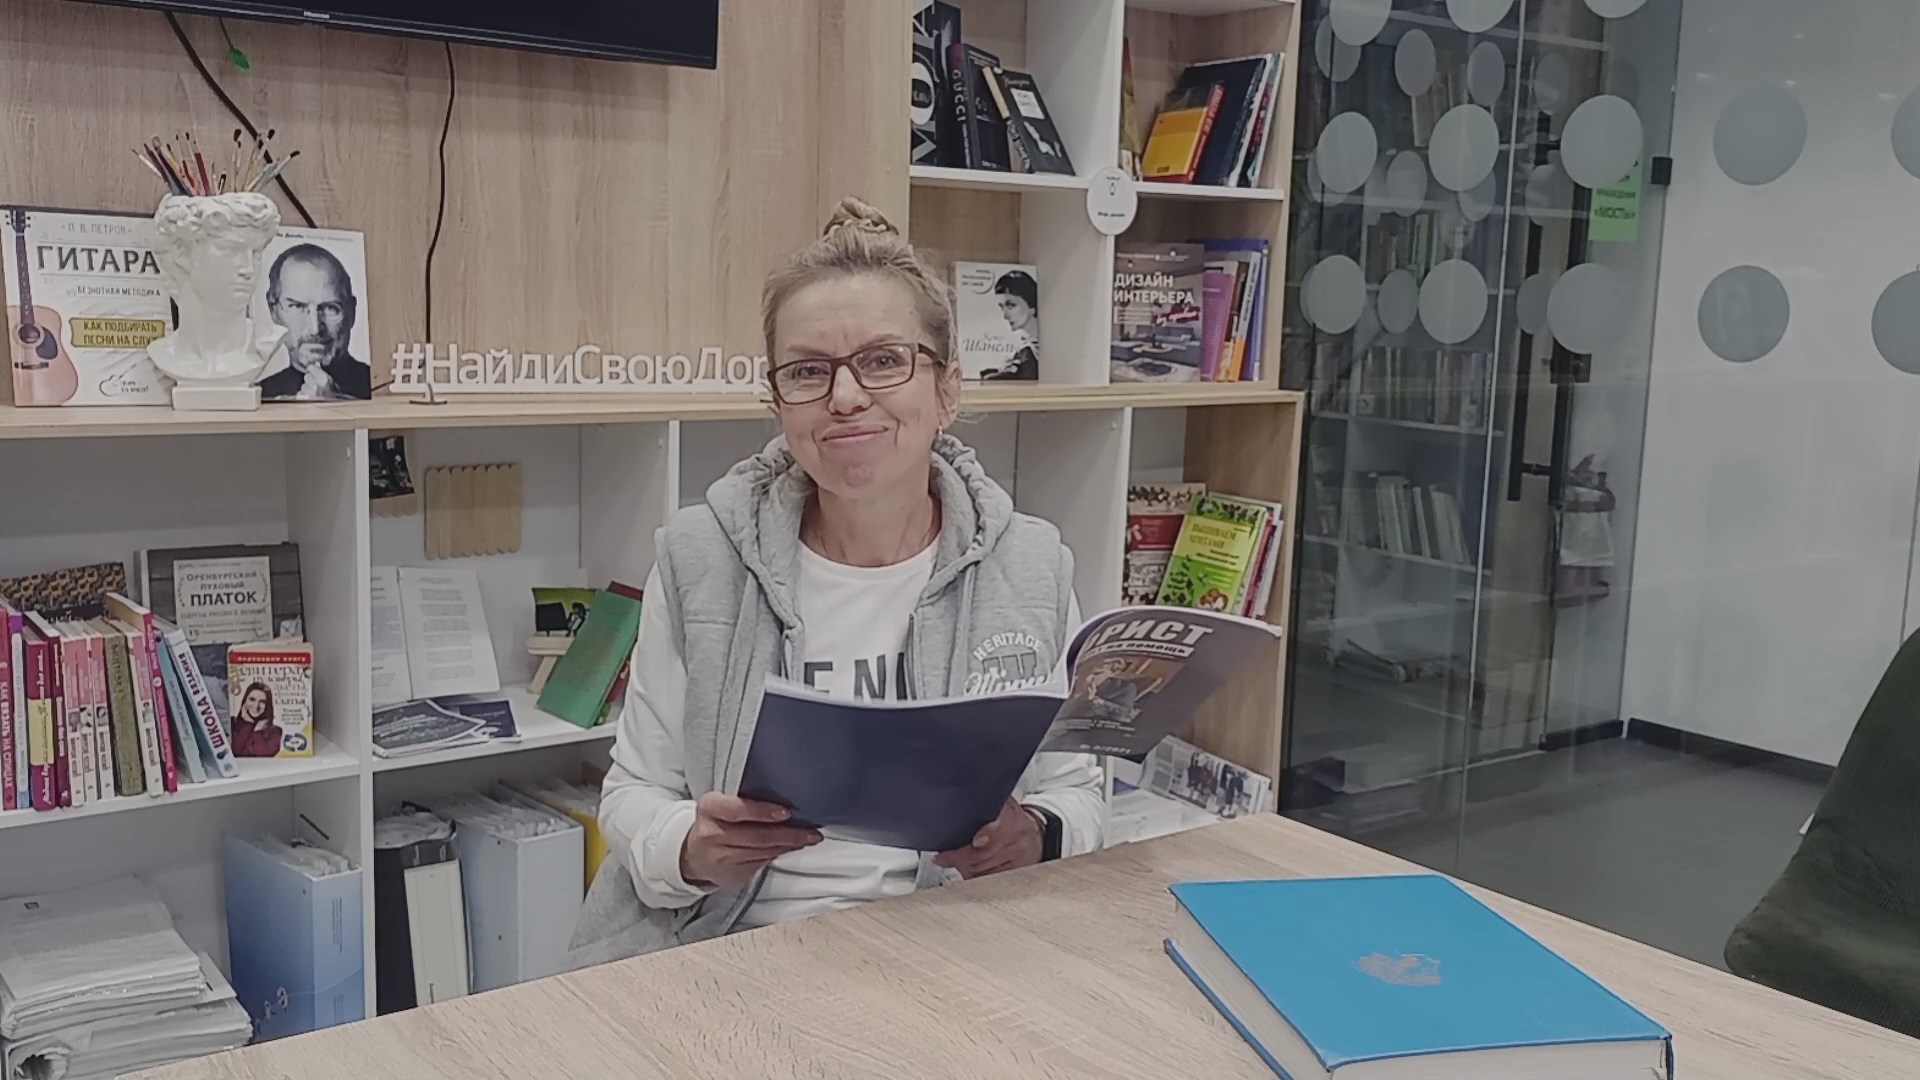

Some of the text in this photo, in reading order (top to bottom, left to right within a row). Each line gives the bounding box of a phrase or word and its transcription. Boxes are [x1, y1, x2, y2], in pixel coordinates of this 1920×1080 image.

[91, 223, 126, 235] ПЕТРОВ
[36, 245, 161, 274] ГИТАРА
[1114, 272, 1174, 288] ДИЗАЙН
[77, 285, 161, 297] БЕЗНОТНАЯ МЕТОДИКА
[1113, 290, 1195, 304] ИНТЕРЬЕРА
[83, 321, 157, 332] КАК ПОДБИРАТЬ
[83, 335, 114, 345] ПЕСНИ
[116, 336, 130, 345] НА
[190, 591, 257, 607] ПЛАТОК
[972, 632, 1042, 662] HERITAGE
[178, 652, 201, 695] ВЯЗАНИЯ
[1, 702, 11, 736] ВЯЗАТЬ
[198, 696, 225, 749] ШКОЛА
